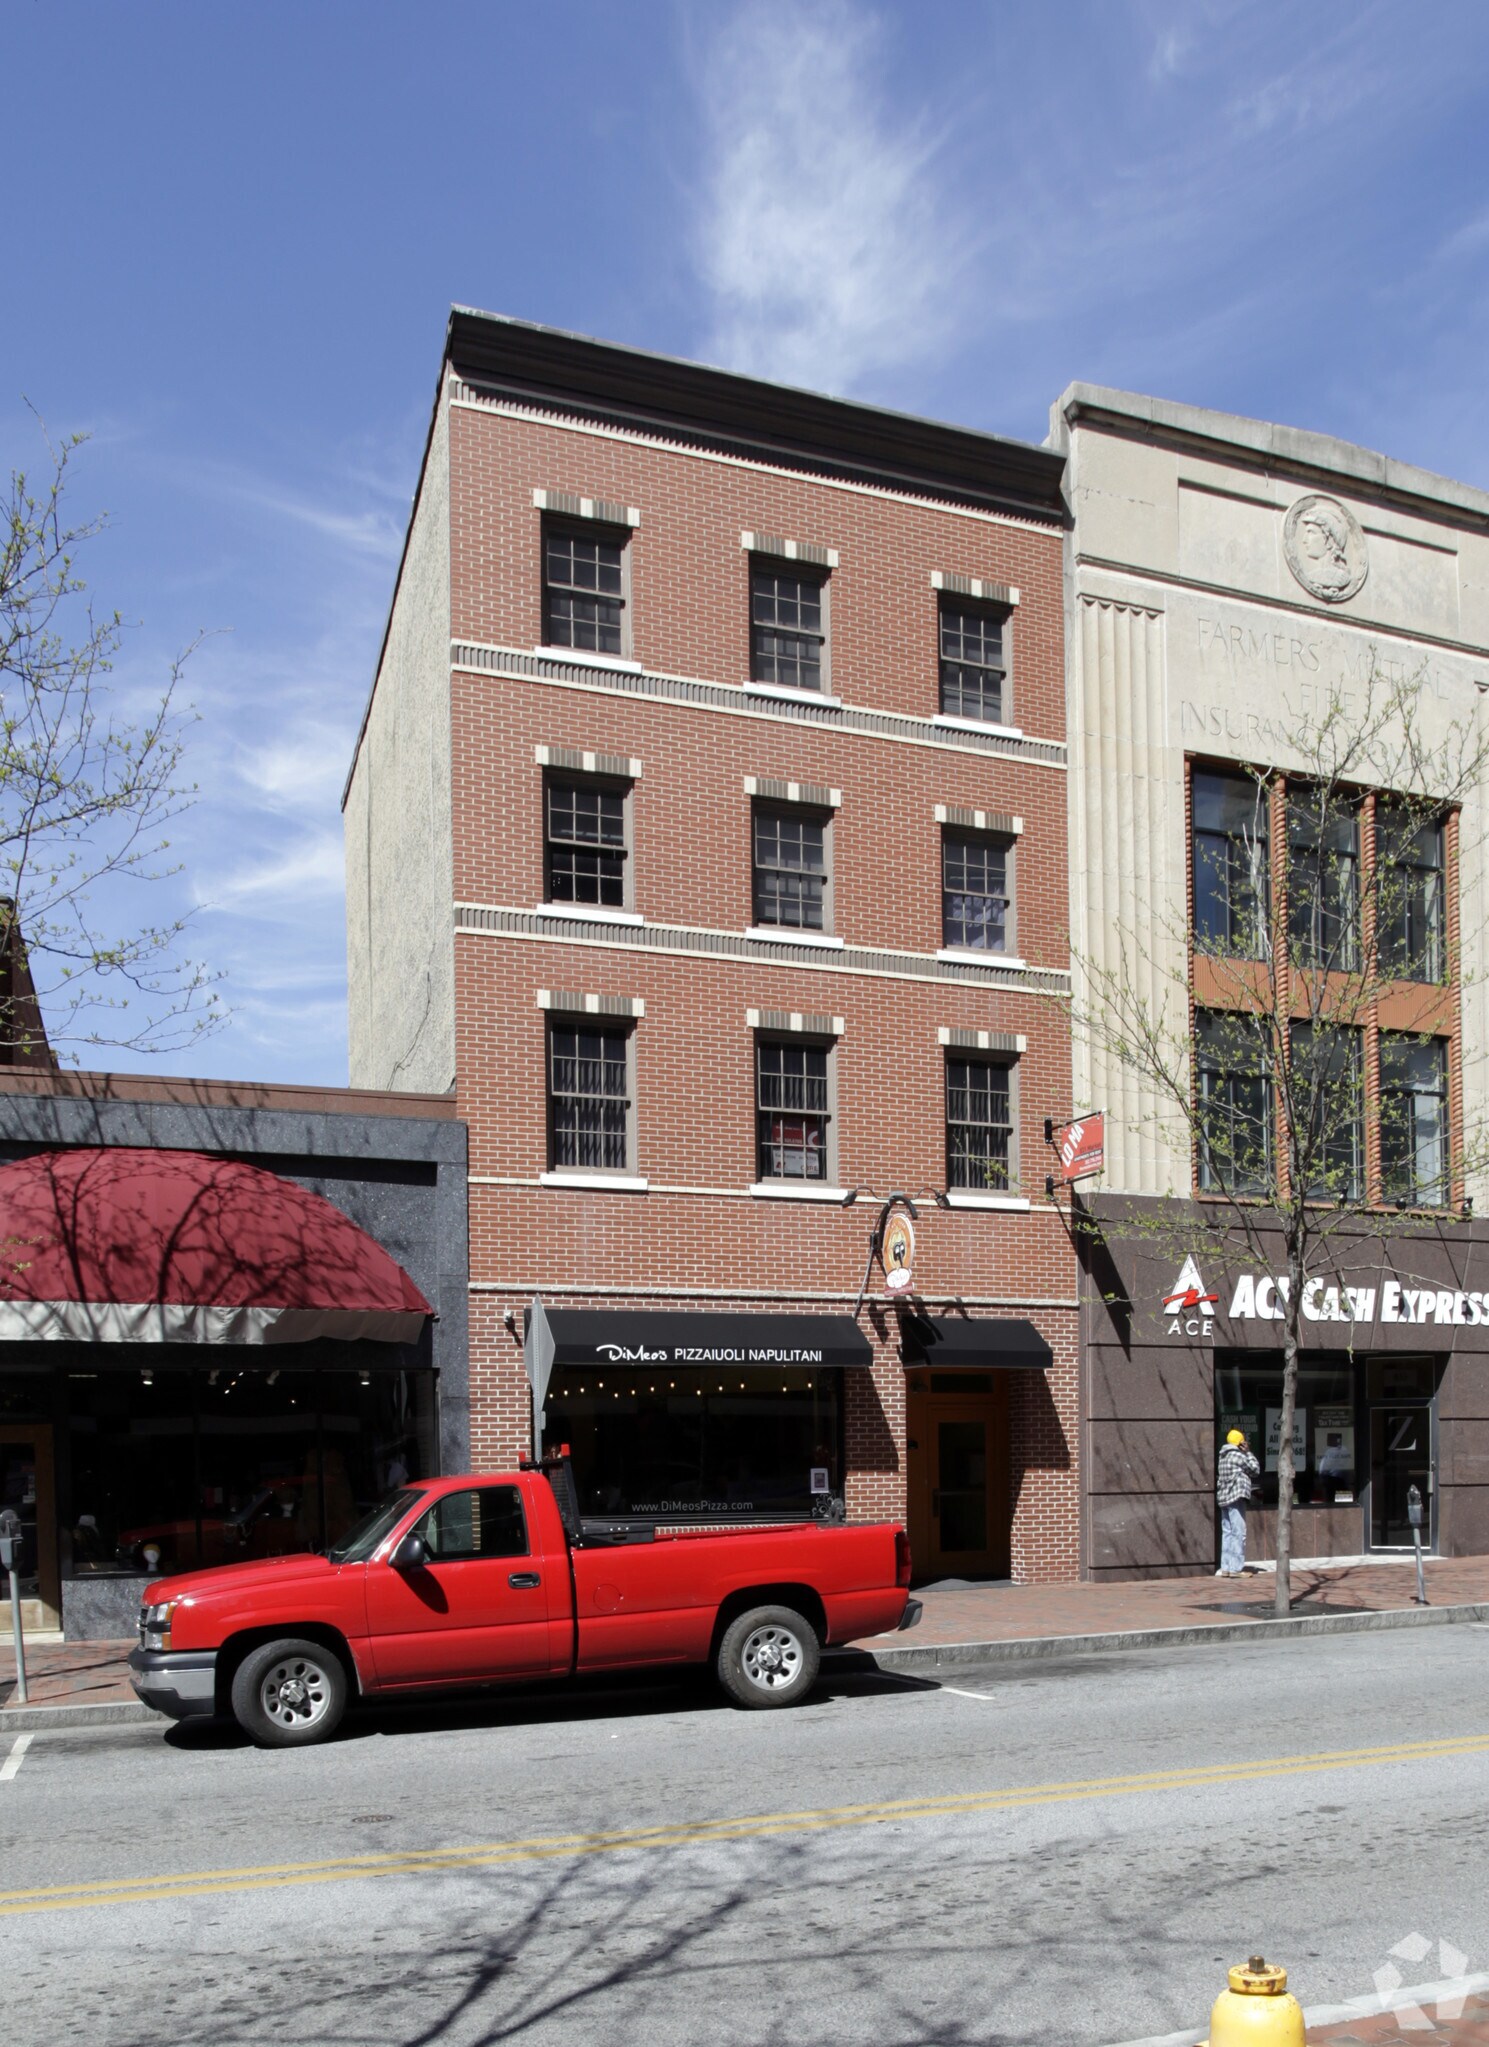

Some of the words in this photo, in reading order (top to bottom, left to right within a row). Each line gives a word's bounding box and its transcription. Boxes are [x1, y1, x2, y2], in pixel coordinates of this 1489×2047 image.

[1343, 649, 1449, 700] MUTUAL
[1300, 683, 1357, 721] FIRE
[1167, 1319, 1213, 1336] ACE
[596, 1344, 668, 1361] DiMeo's
[674, 1348, 745, 1361] PIZZAIUOLI
[749, 1349, 822, 1362] NAPULITANI
[1269, 1434, 1278, 1443] All
[1387, 1416, 1417, 1451] Z
[631, 1500, 754, 1512] www.DiMeosPizza.com
